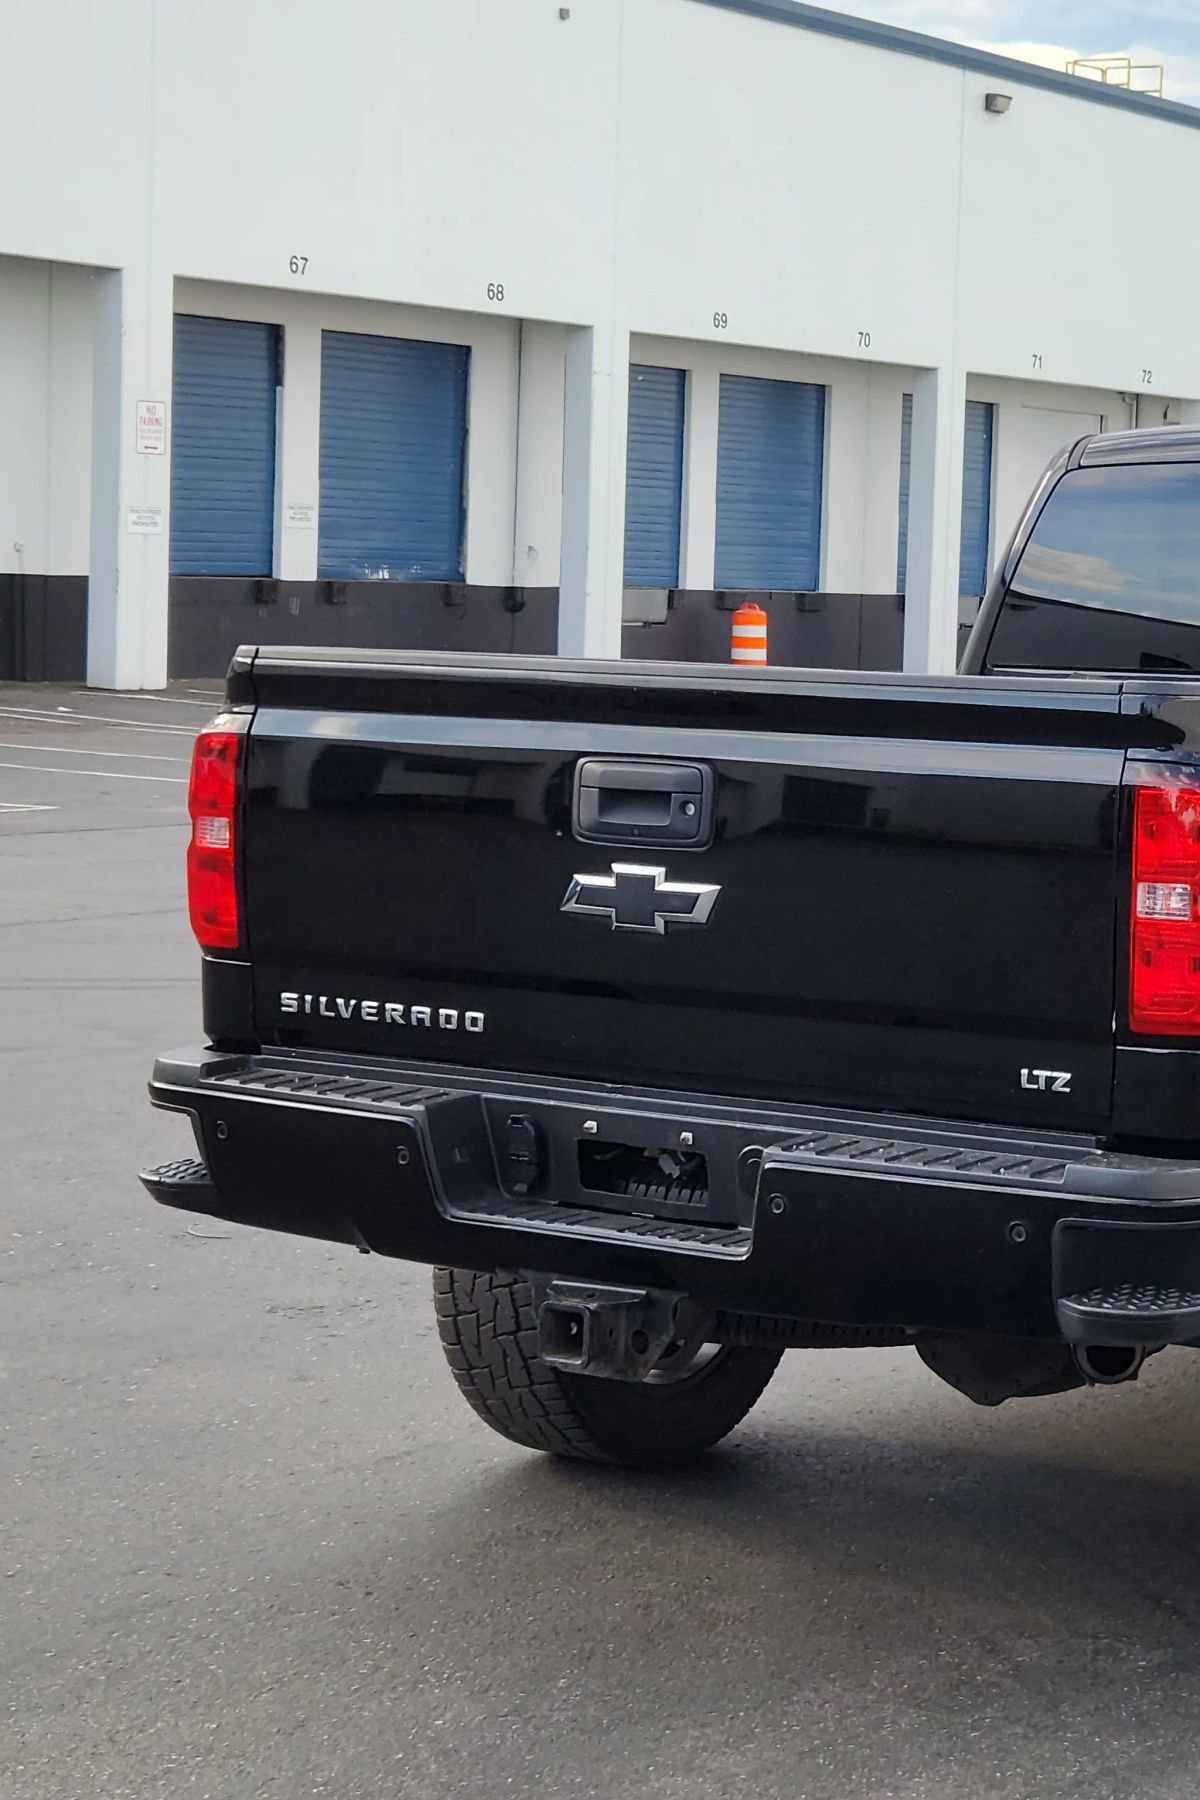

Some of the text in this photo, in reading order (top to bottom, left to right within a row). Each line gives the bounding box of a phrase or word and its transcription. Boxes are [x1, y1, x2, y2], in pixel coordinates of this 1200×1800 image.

[289, 255, 309, 275] 67
[487, 283, 505, 301] 68
[713, 312, 728, 329] 69
[858, 331, 871, 348] 70
[1032, 354, 1042, 369] 71
[1142, 369, 1152, 384] 72
[145, 405, 157, 416] NO
[280, 992, 485, 1032] SILVERADO
[1020, 1068, 1072, 1093] LTZ
